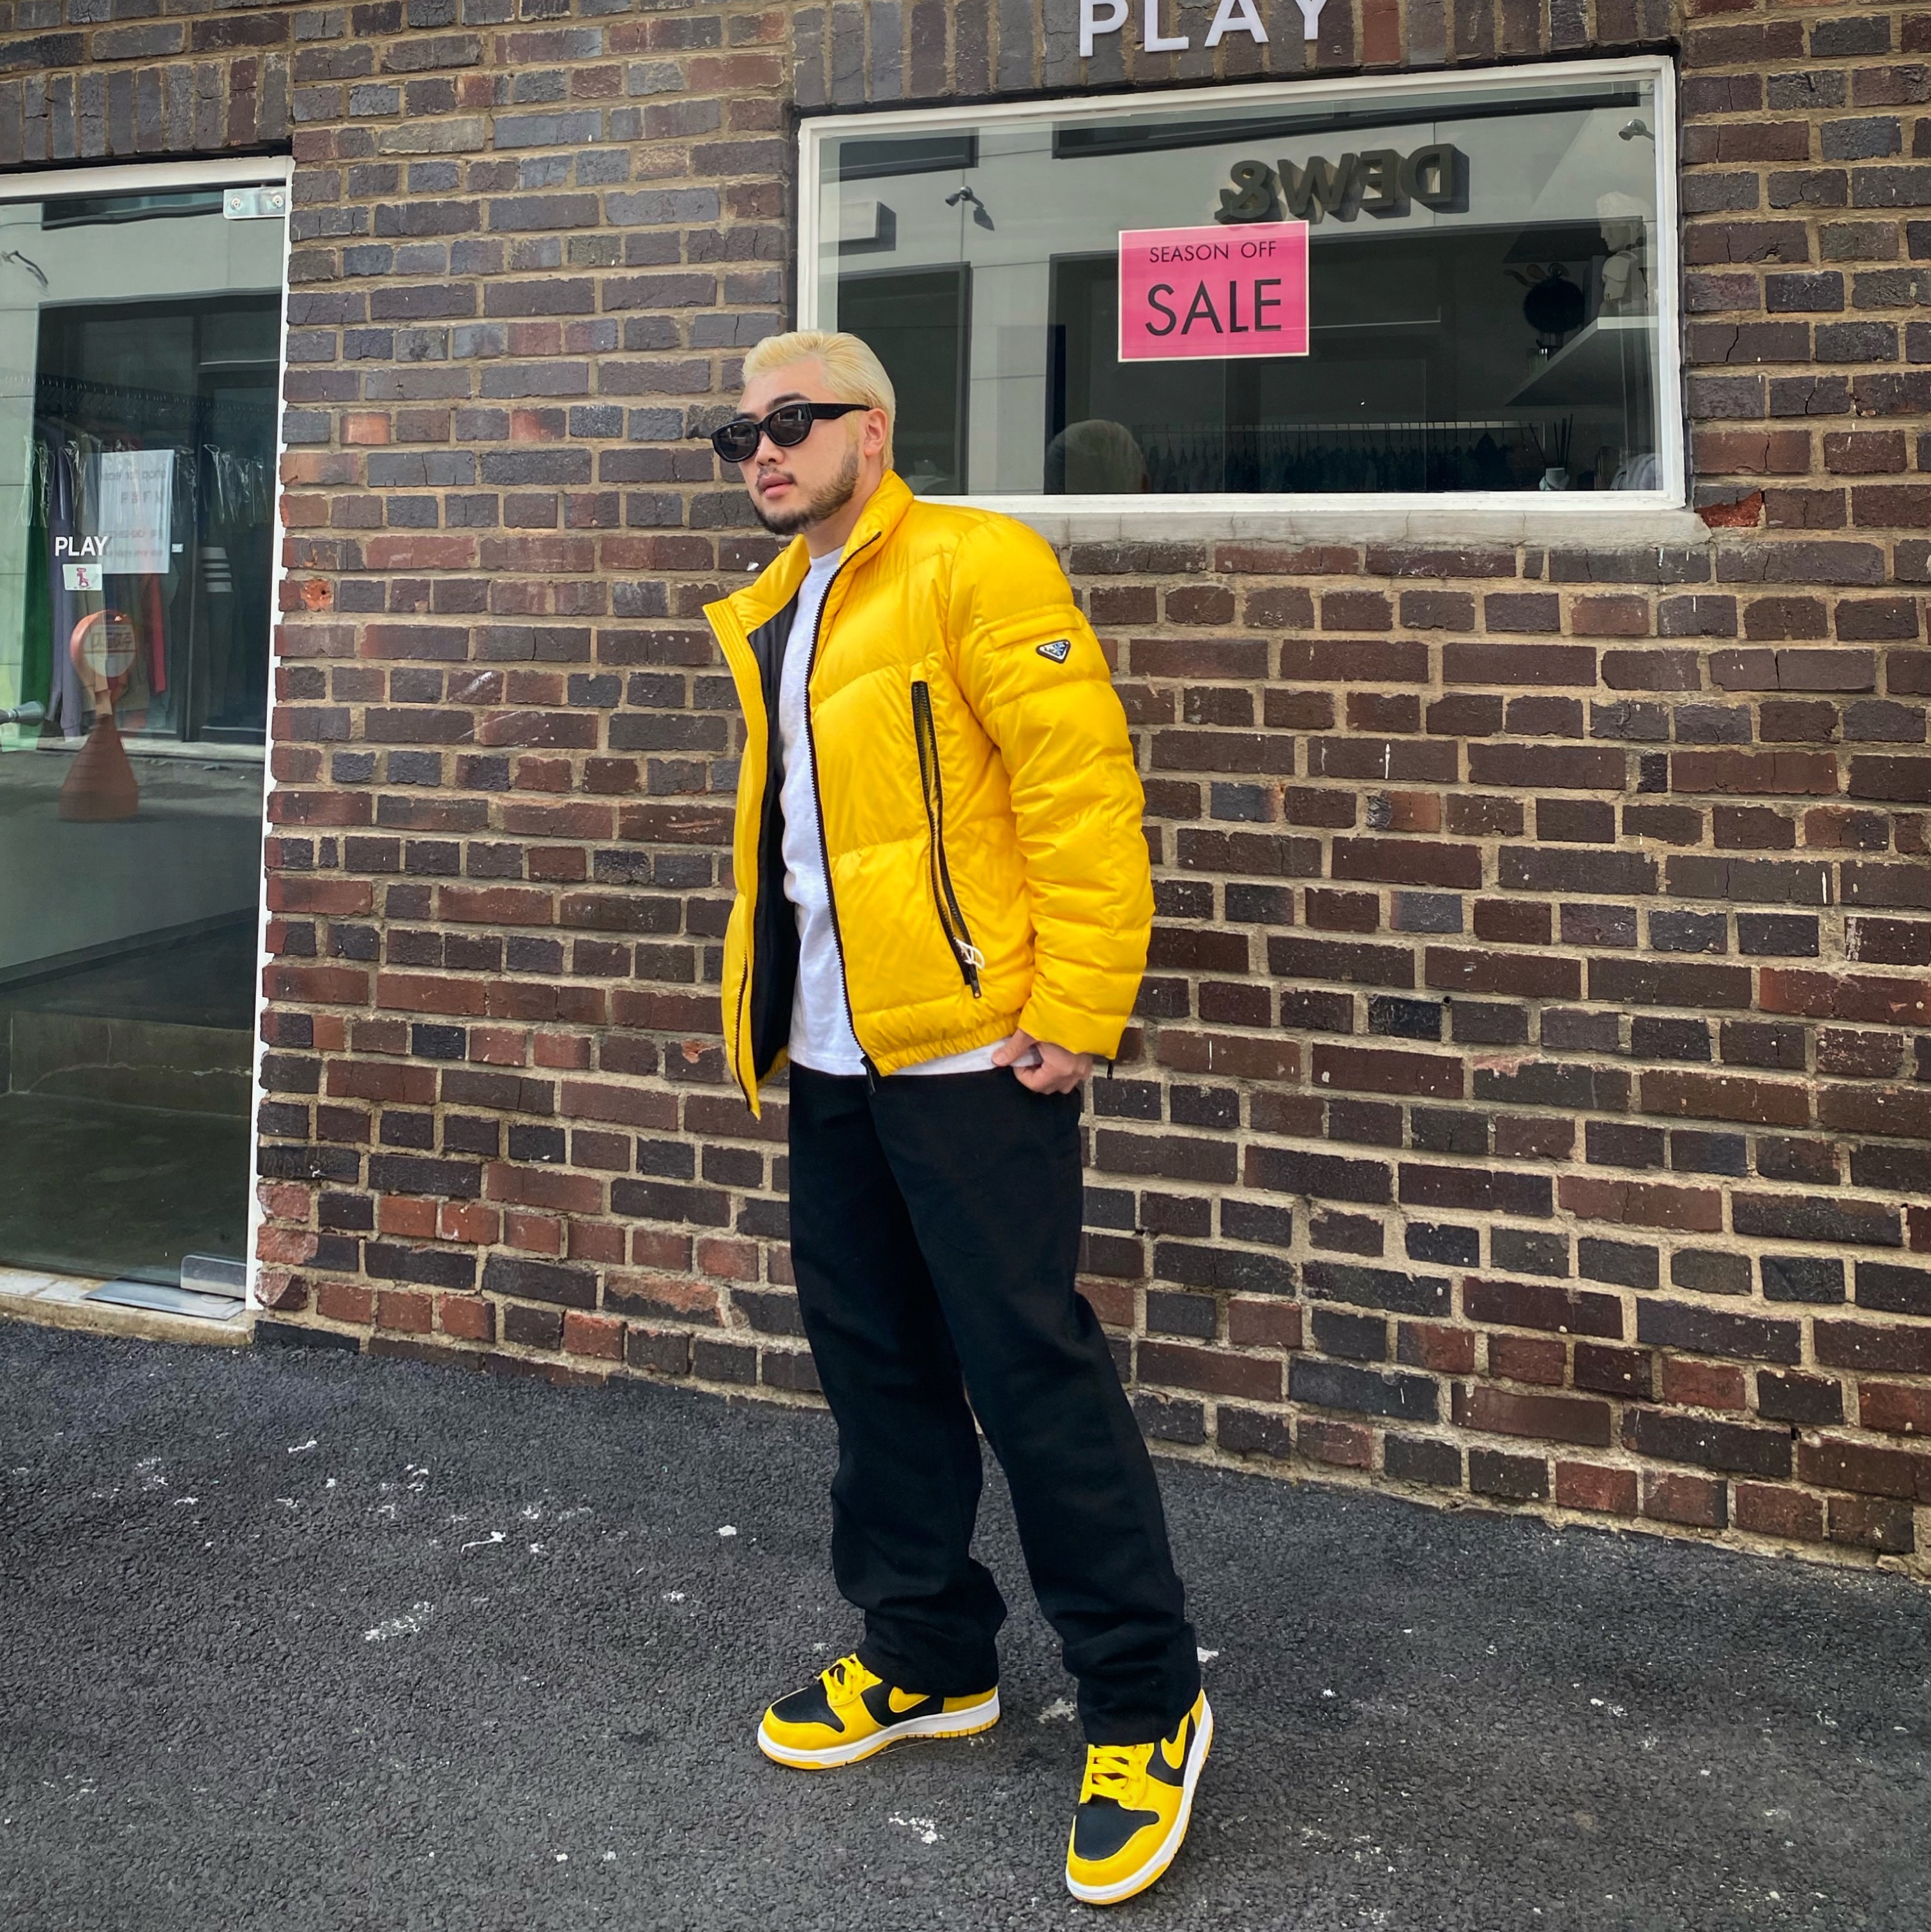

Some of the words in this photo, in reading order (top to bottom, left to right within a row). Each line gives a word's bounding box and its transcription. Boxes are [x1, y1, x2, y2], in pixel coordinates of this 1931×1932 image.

[1079, 0, 1327, 57] PLAY
[1149, 243, 1229, 263] SEASON
[1241, 241, 1277, 258] OFF
[1145, 278, 1282, 337] SALE
[55, 536, 108, 556] PLAY
